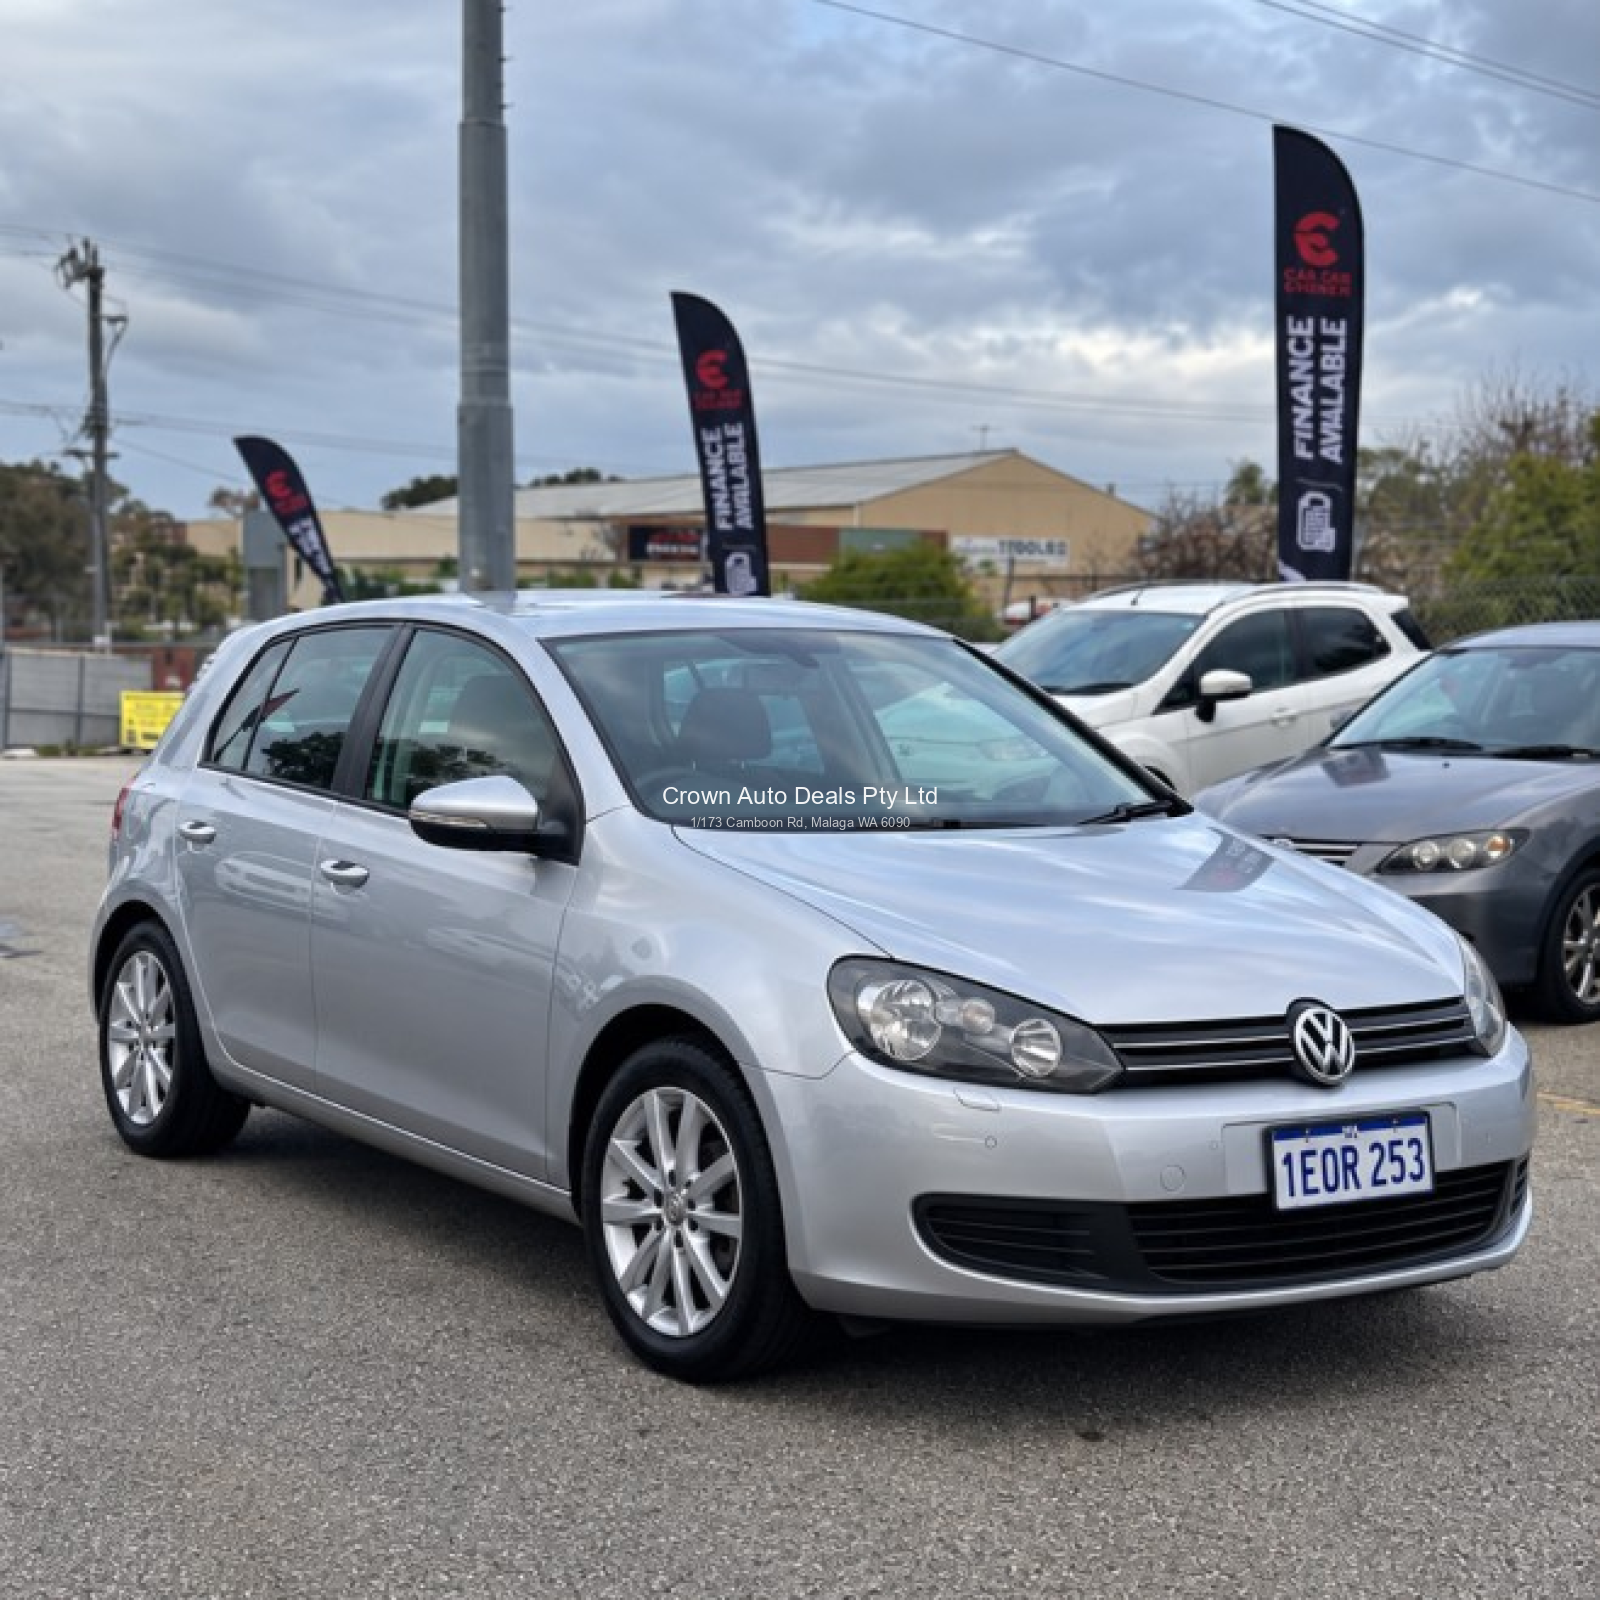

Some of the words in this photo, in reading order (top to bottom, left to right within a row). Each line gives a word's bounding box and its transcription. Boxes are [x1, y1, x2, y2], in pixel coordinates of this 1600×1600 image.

[1286, 314, 1314, 459] FINANCE
[701, 427, 734, 530] FINANCE
[1281, 1144, 1362, 1198] 1EOR
[1368, 1137, 1426, 1188] 253
